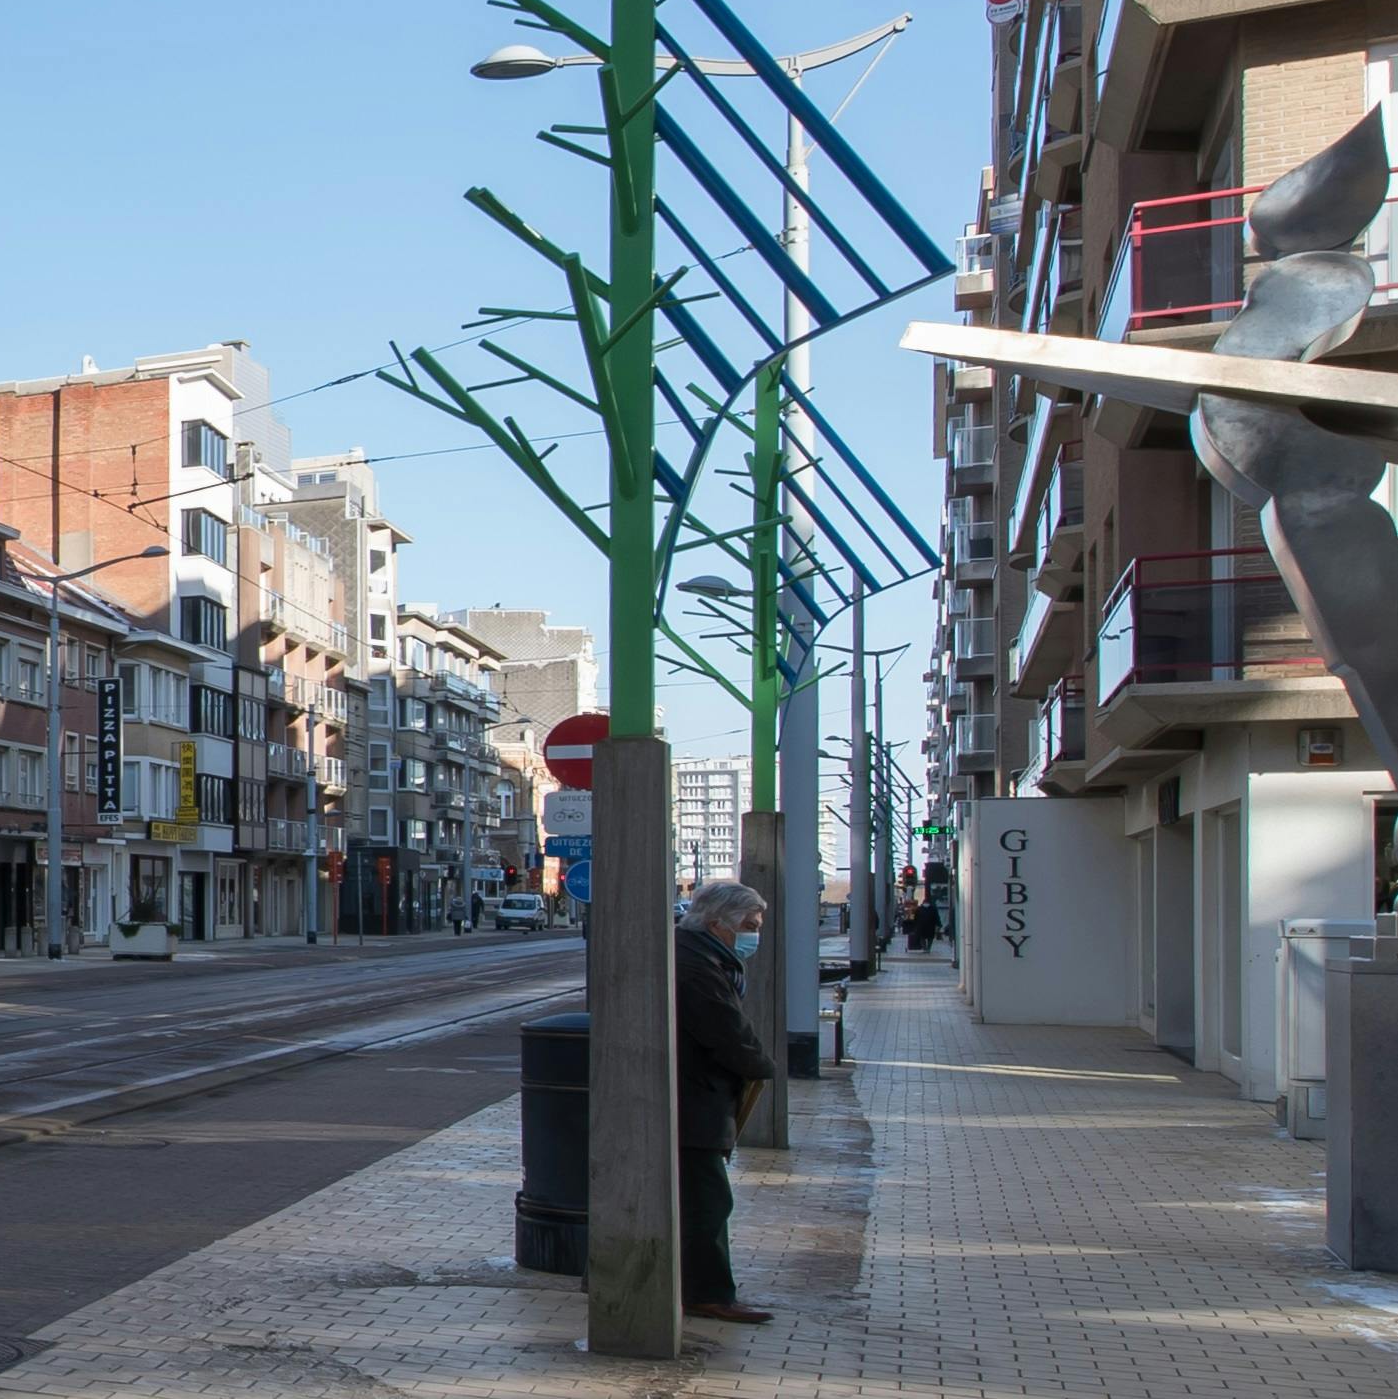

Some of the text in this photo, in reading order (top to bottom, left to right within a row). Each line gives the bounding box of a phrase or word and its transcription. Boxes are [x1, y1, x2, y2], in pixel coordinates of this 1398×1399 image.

[103, 683, 117, 810] PIZZA PITTA
[99, 814, 119, 822] EFES
[569, 847, 583, 856] DE
[1000, 829, 1031, 958] GIBSY
